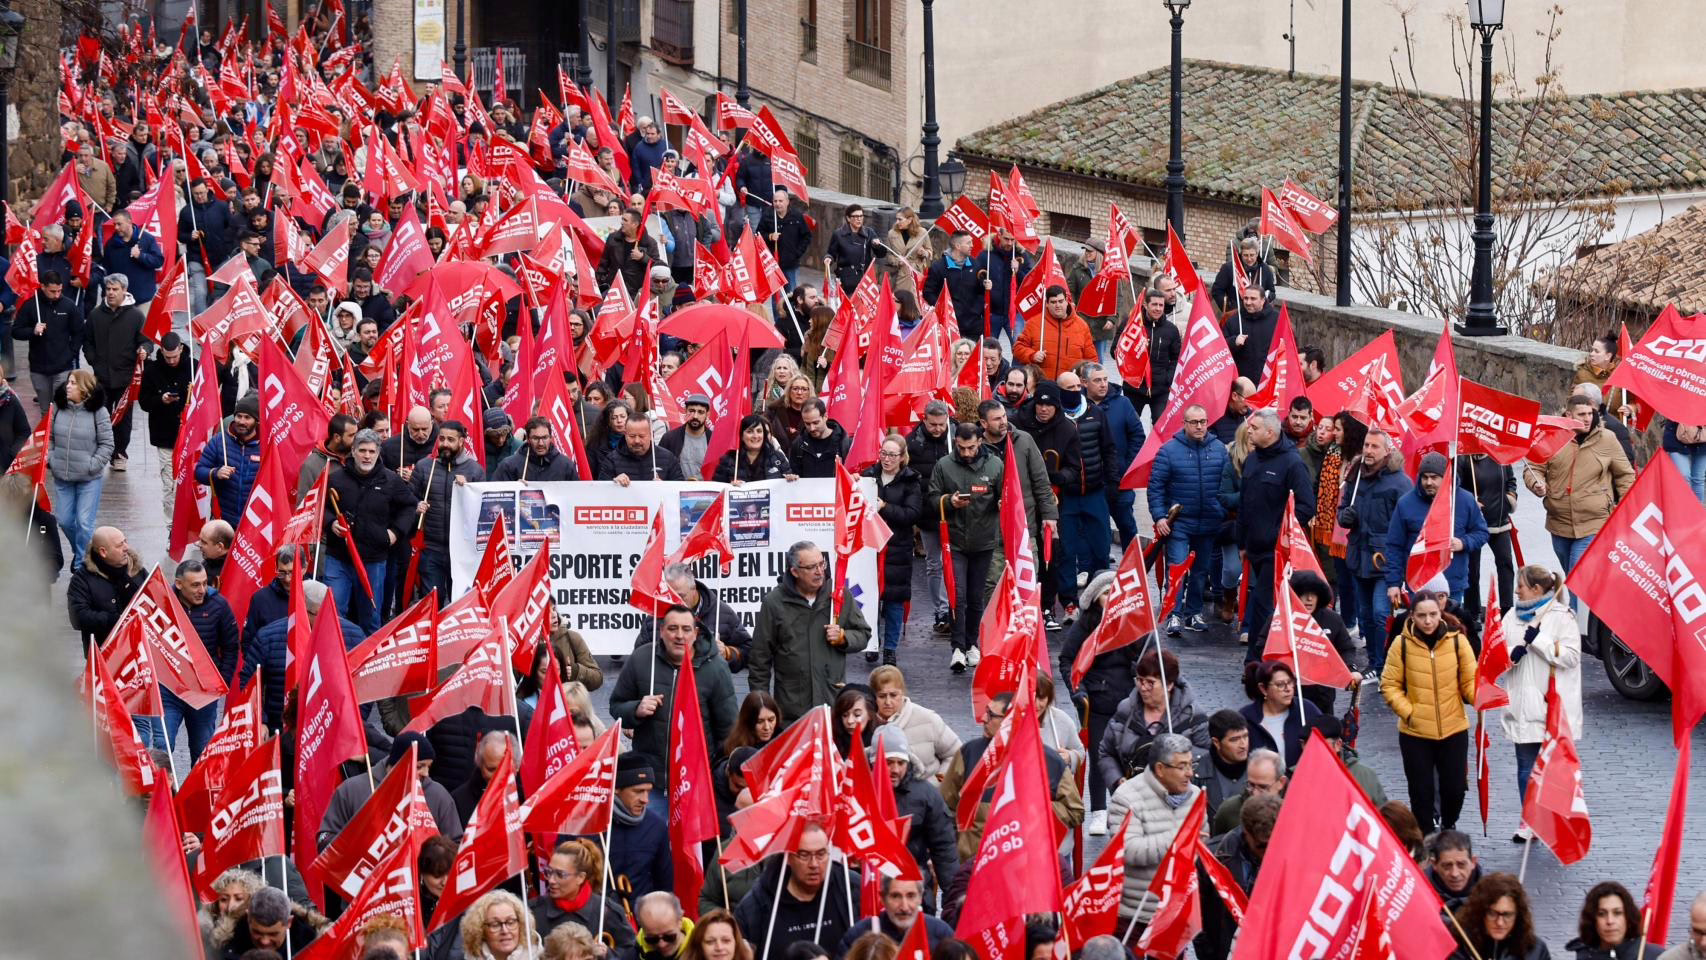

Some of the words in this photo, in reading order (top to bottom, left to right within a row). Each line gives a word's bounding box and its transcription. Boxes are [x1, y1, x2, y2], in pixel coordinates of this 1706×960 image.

[753, 116, 781, 147] CCOO
[951, 204, 985, 239] CCOO
[882, 354, 892, 364] de
[1679, 379, 1706, 397] Manc
[1462, 402, 1504, 431] CCOO
[578, 510, 624, 520] CCOO
[790, 507, 834, 518] CCOO
[1608, 550, 1620, 564] de
[511, 553, 622, 579] RSPORTE
[738, 553, 761, 578] EN
[557, 588, 631, 605] DEFENSA
[578, 613, 648, 630] PERSON
